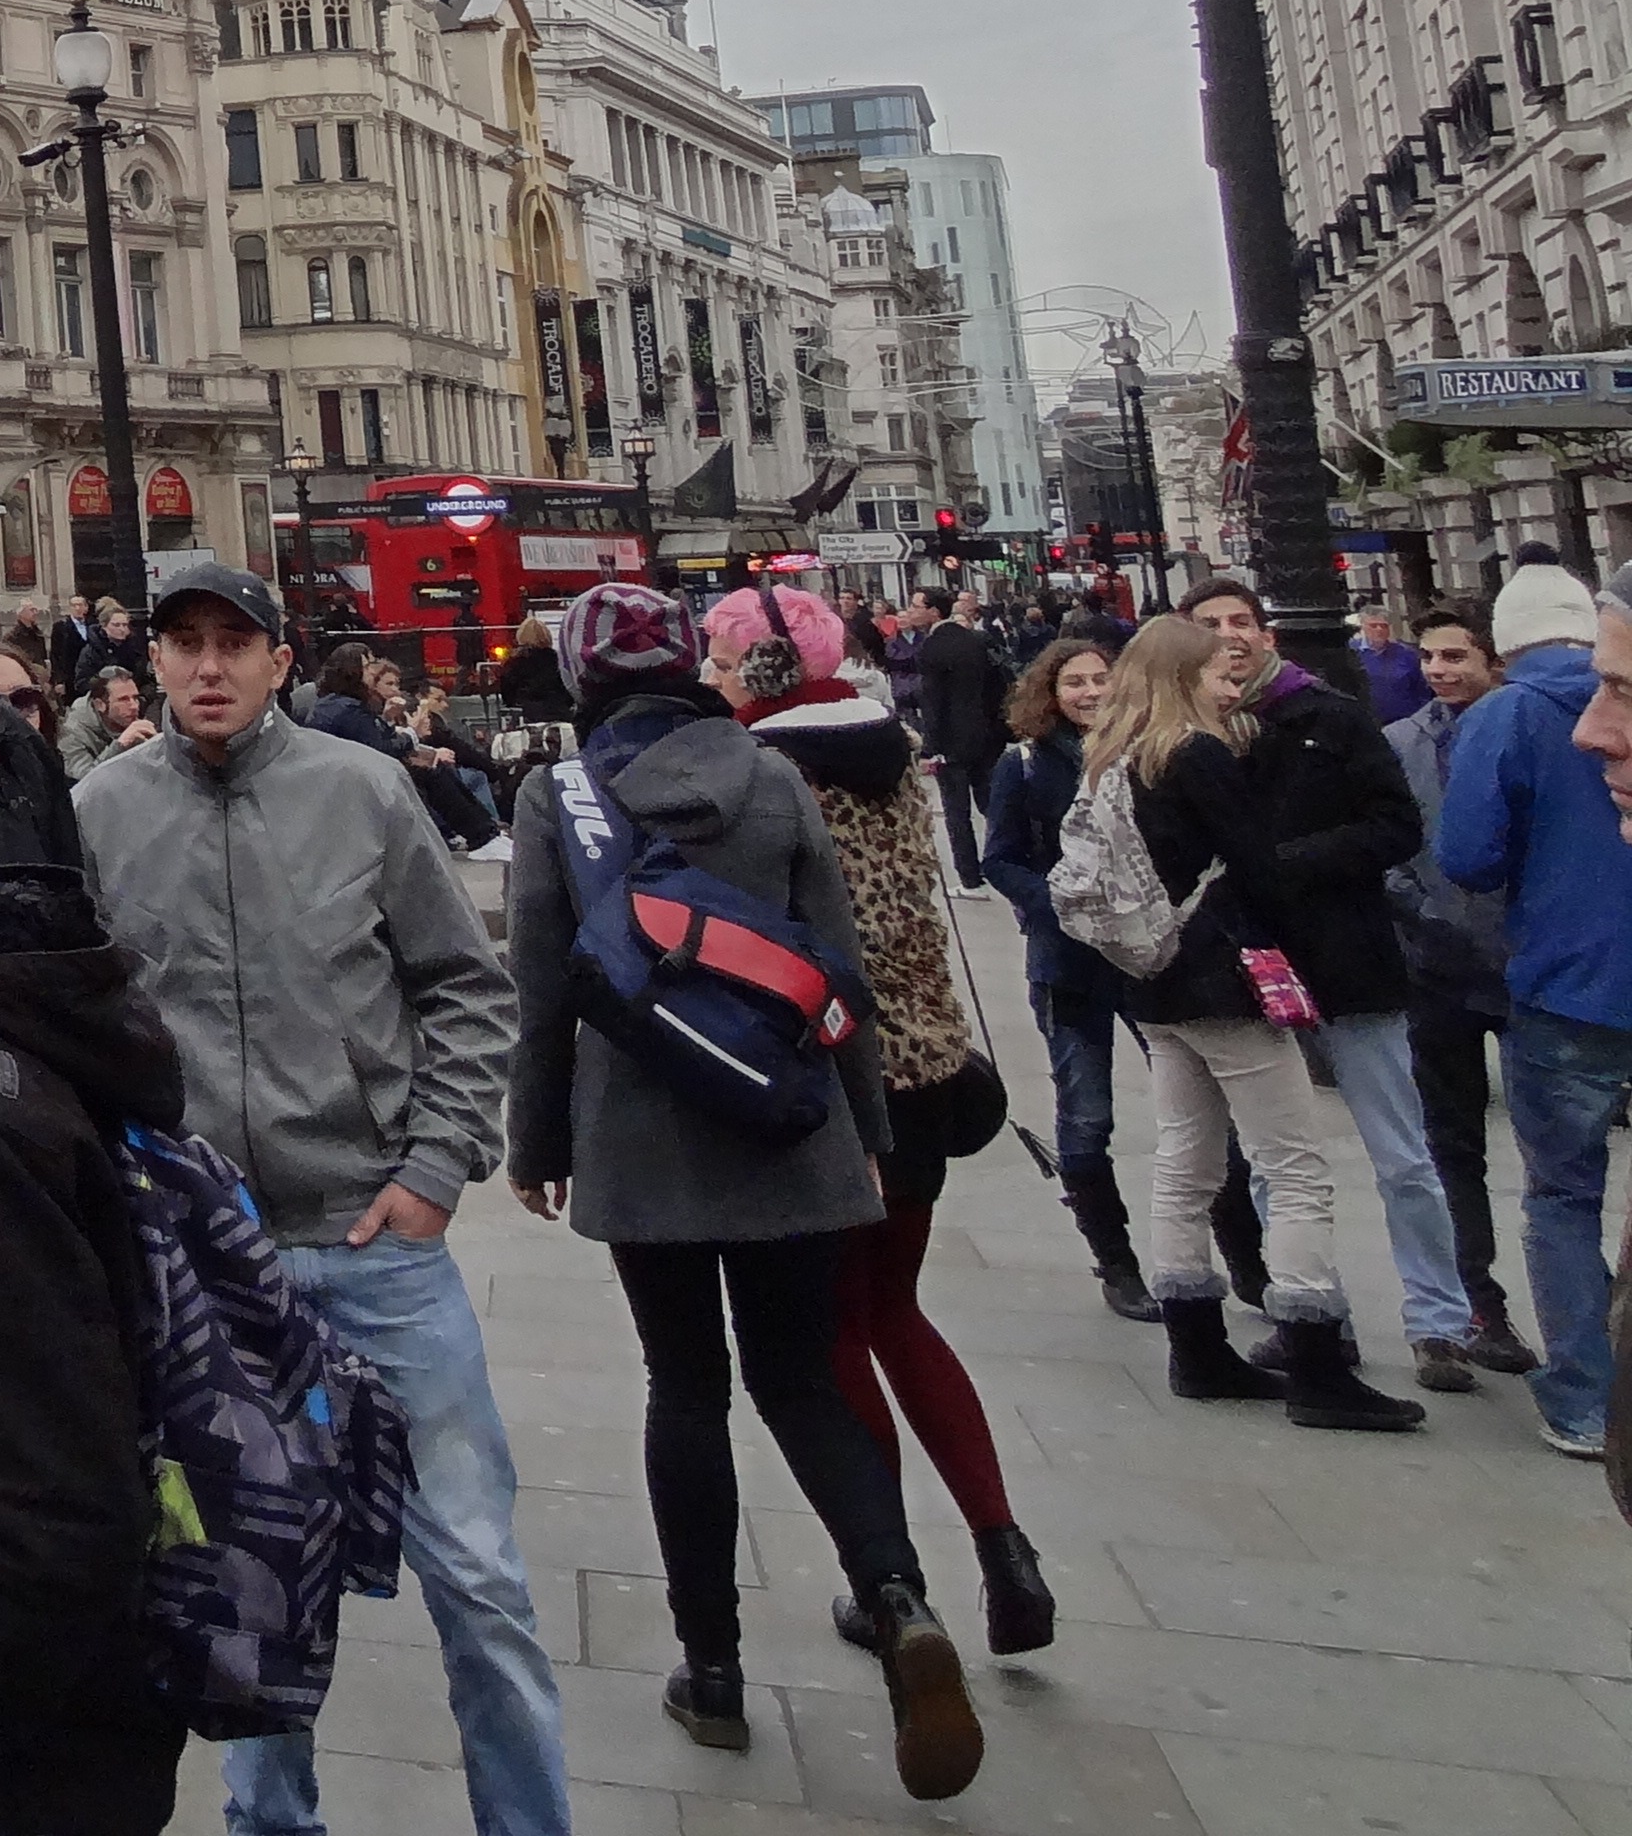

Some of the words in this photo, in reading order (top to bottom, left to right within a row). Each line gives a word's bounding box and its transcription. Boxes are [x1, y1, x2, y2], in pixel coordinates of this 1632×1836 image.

[635, 303, 659, 395] TROCADERO
[1439, 370, 1581, 398] RESTAURANT
[426, 499, 507, 512] UNDERGROUND
[426, 558, 437, 571] 6
